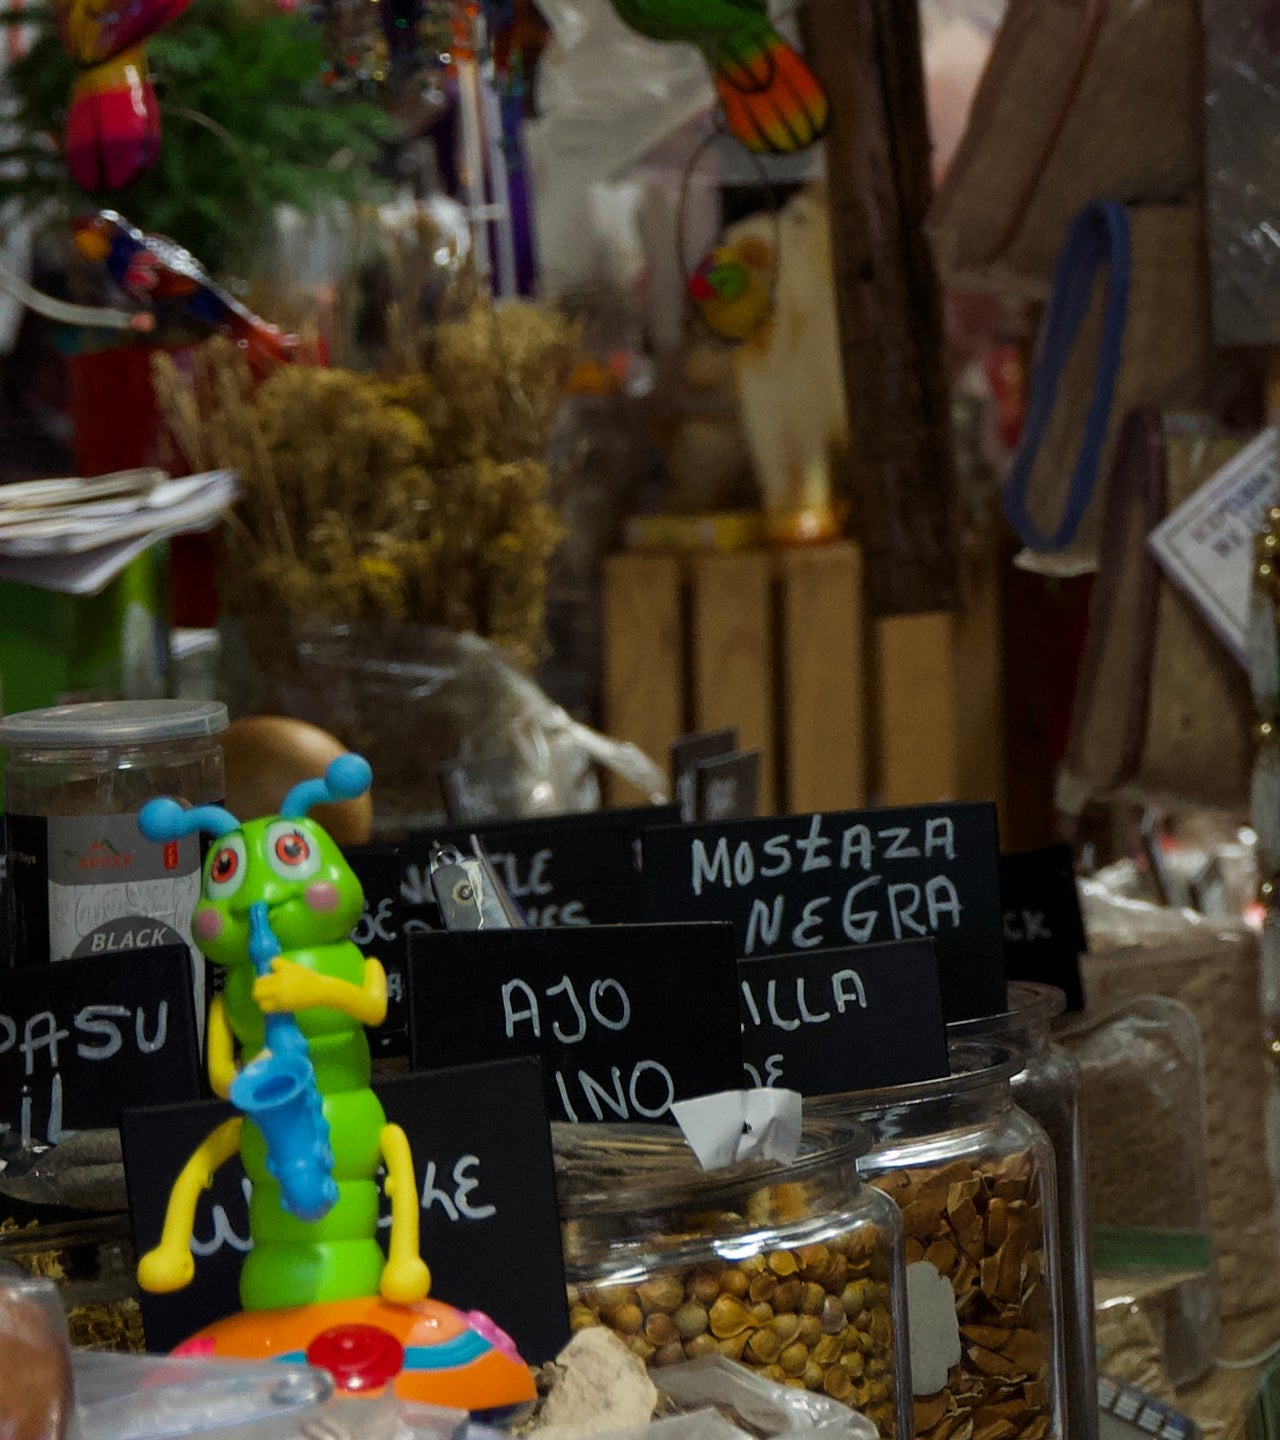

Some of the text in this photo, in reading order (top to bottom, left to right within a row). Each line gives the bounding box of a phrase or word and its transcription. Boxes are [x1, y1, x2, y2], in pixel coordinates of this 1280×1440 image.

[91, 927, 167, 952] BLACK
[744, 874, 963, 954] NEGRA
[500, 973, 632, 1045] AJO
[740, 968, 868, 1031] ILLA
[554, 1058, 675, 1123] INO
